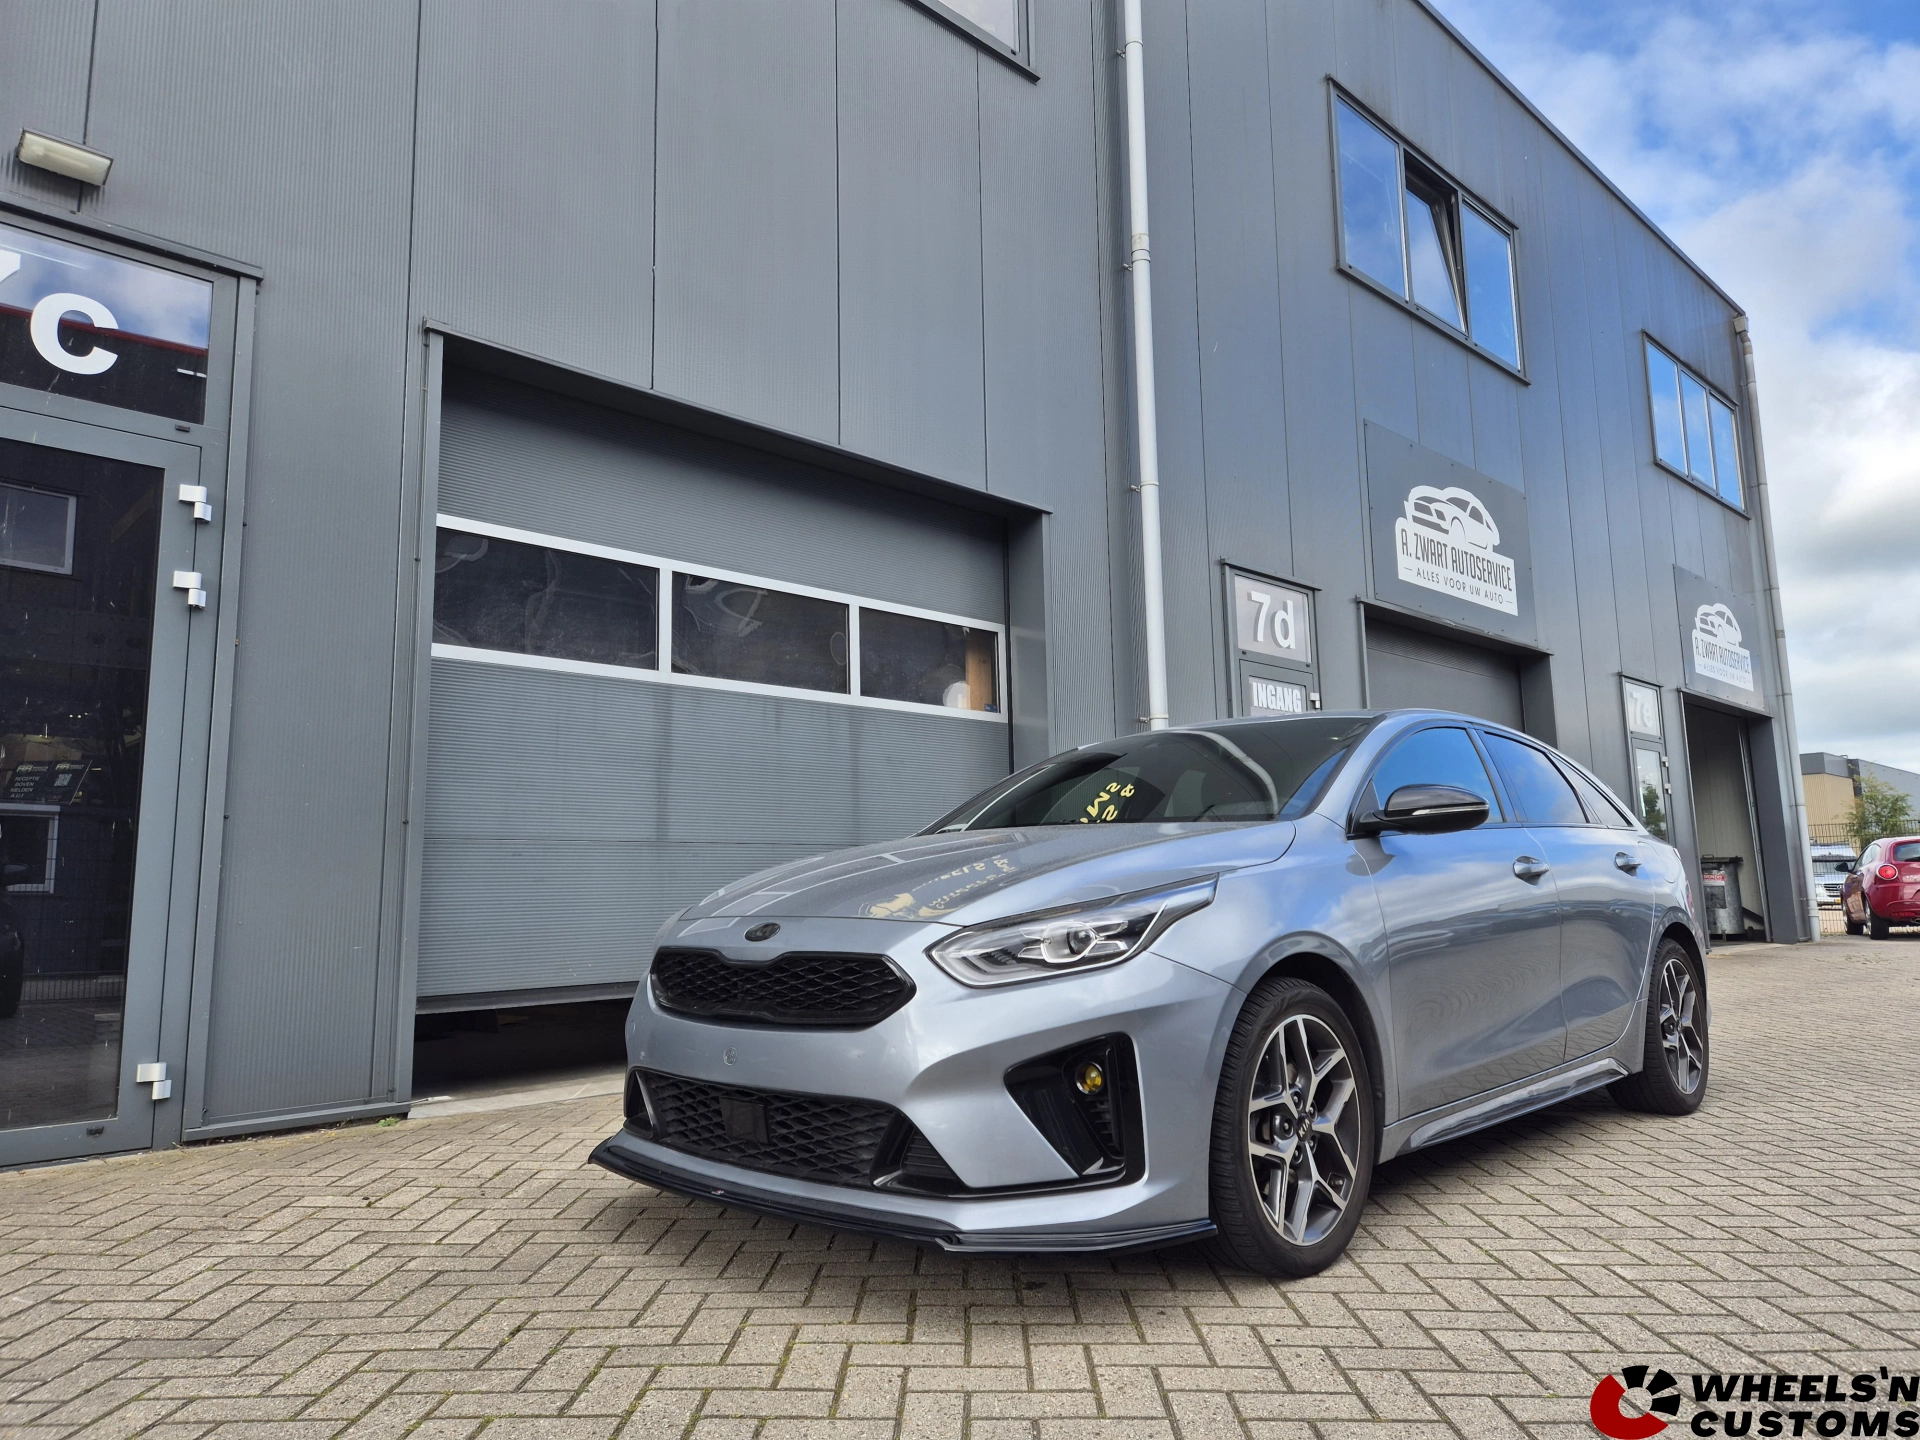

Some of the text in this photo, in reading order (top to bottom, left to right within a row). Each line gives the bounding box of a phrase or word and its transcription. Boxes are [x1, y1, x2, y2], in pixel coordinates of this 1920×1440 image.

[0, 249, 118, 374] c
[1401, 528, 1512, 591] A. ZWART AUTOSERVICE
[1416, 568, 1504, 604] ALLES VOOR UW AUTO
[1248, 591, 1295, 649] 7d
[1253, 681, 1302, 713] INGANG
[1298, 1118, 1311, 1138] KIA
